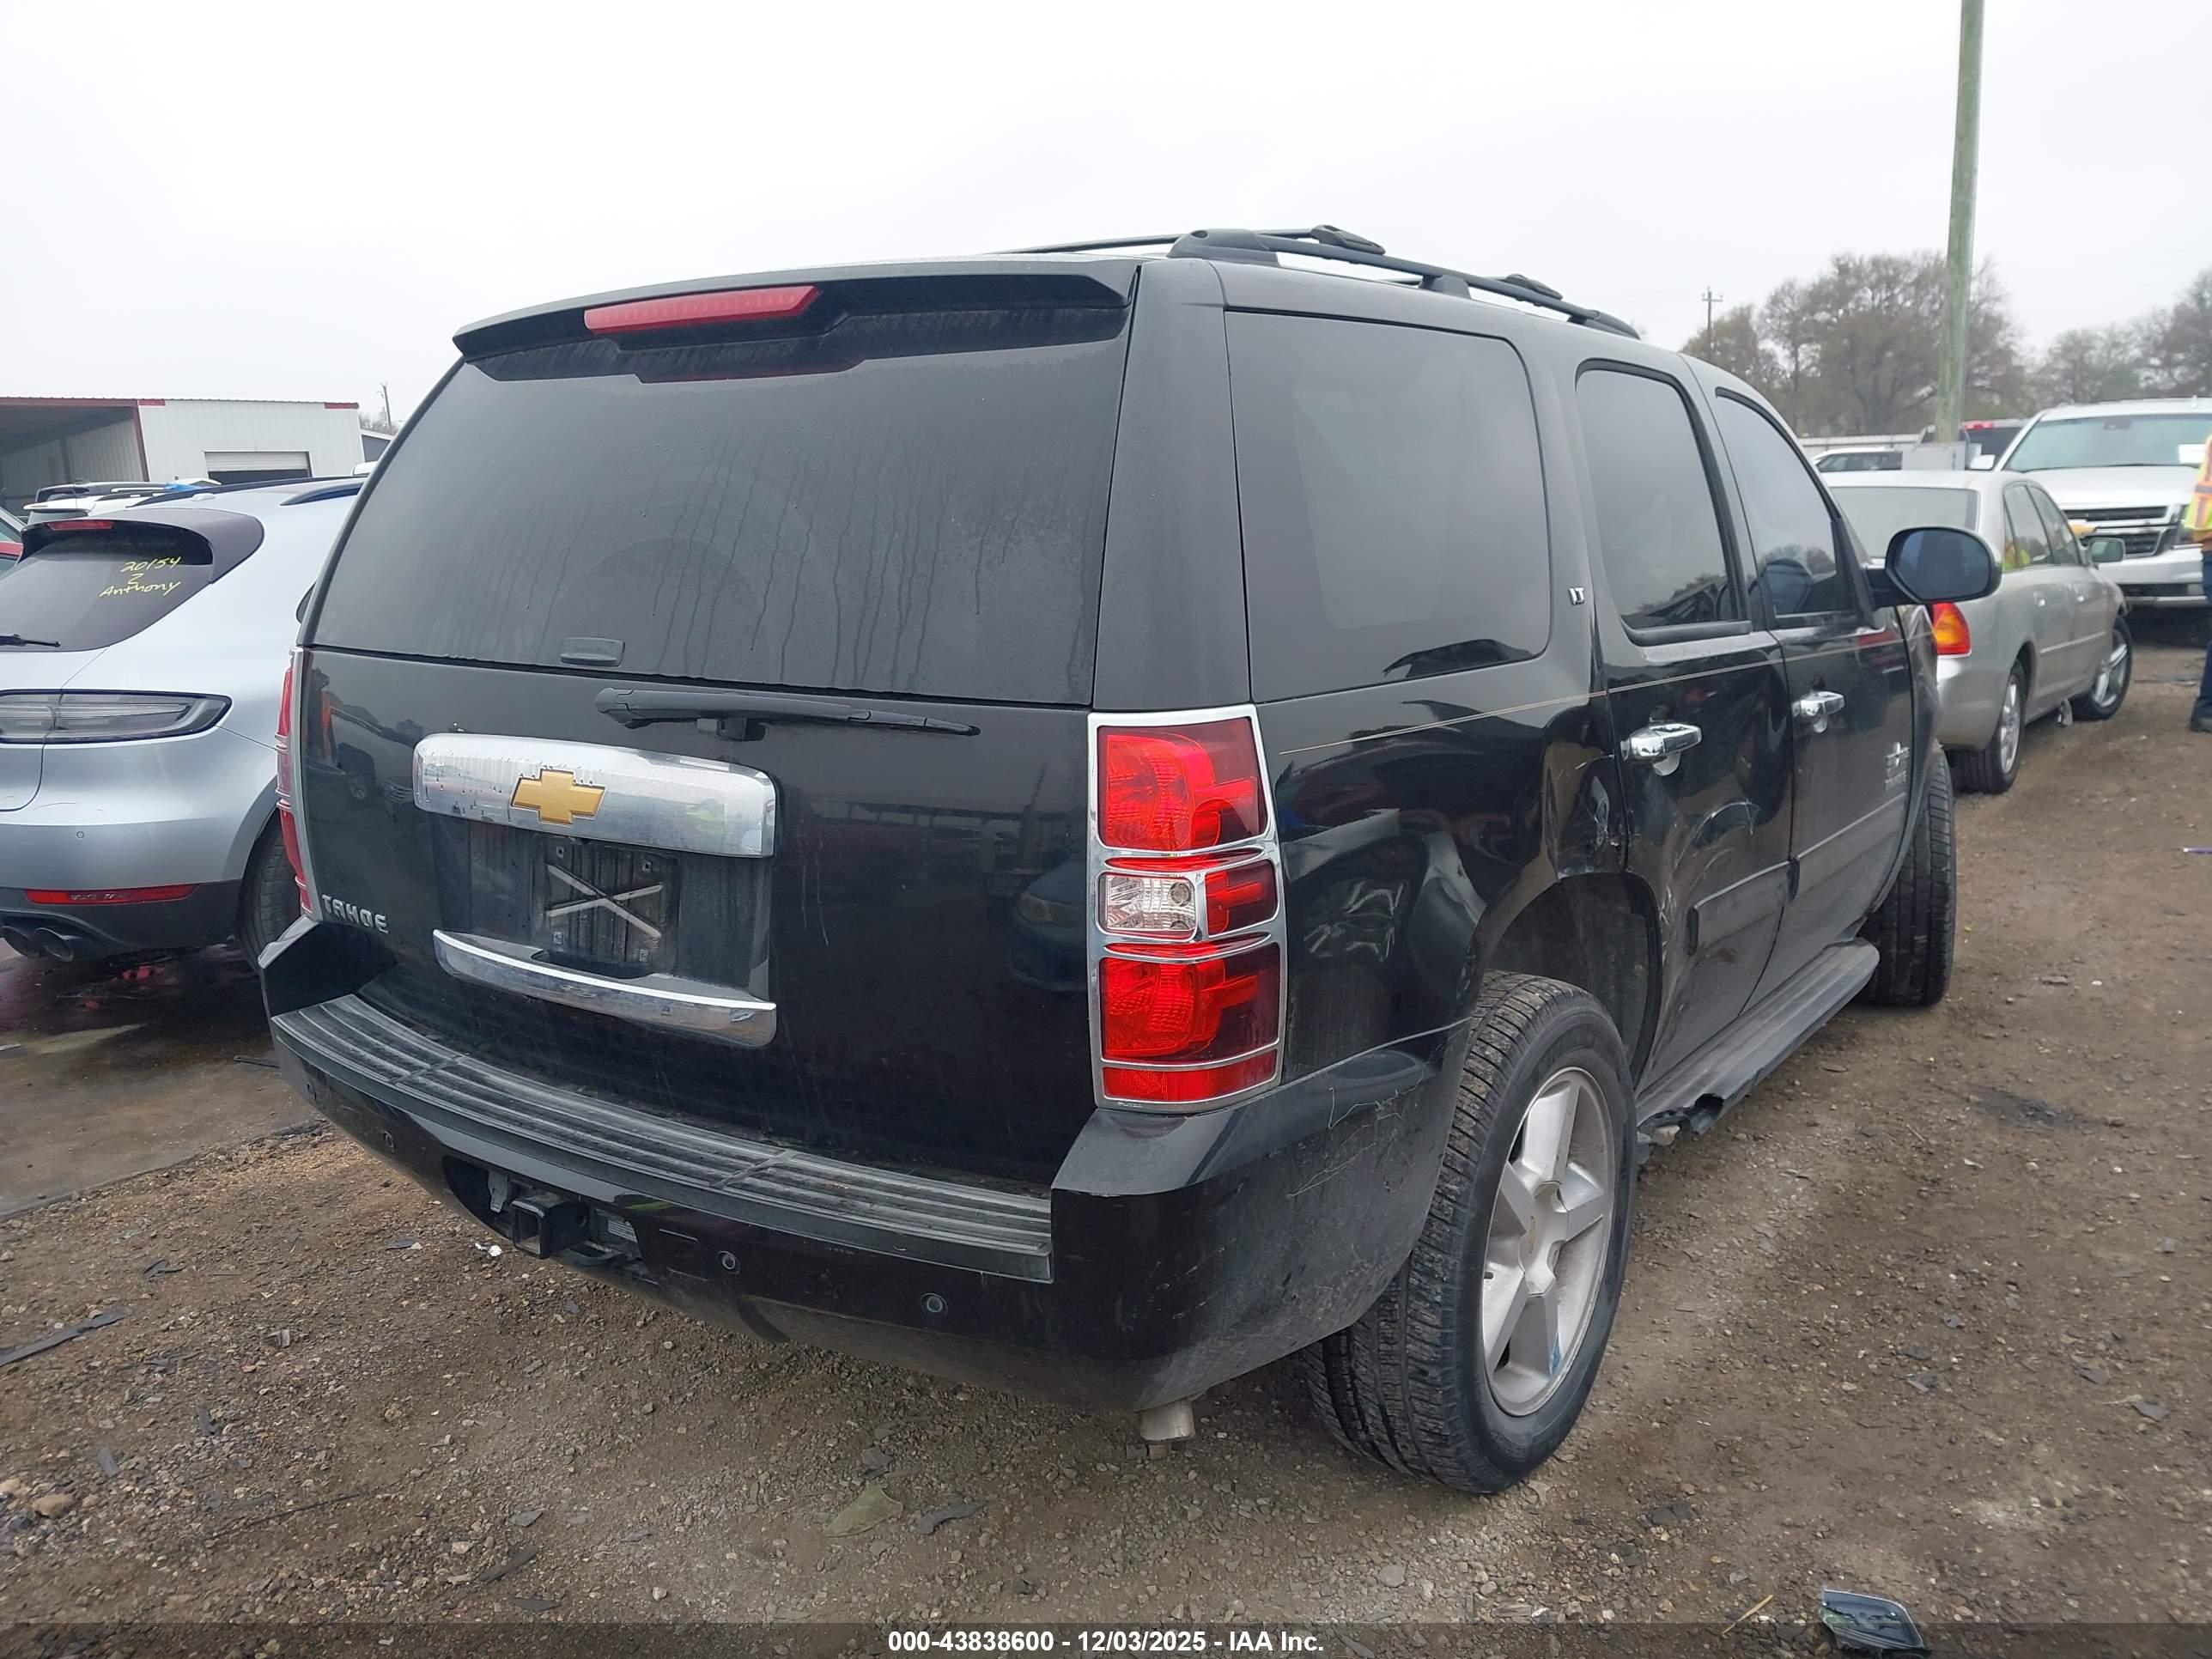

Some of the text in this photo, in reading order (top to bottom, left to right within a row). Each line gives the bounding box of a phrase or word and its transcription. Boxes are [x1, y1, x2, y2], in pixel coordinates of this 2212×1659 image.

[120, 556, 181, 573] 20154
[99, 580, 181, 597] Anthony
[321, 894, 389, 935] TAHOE
